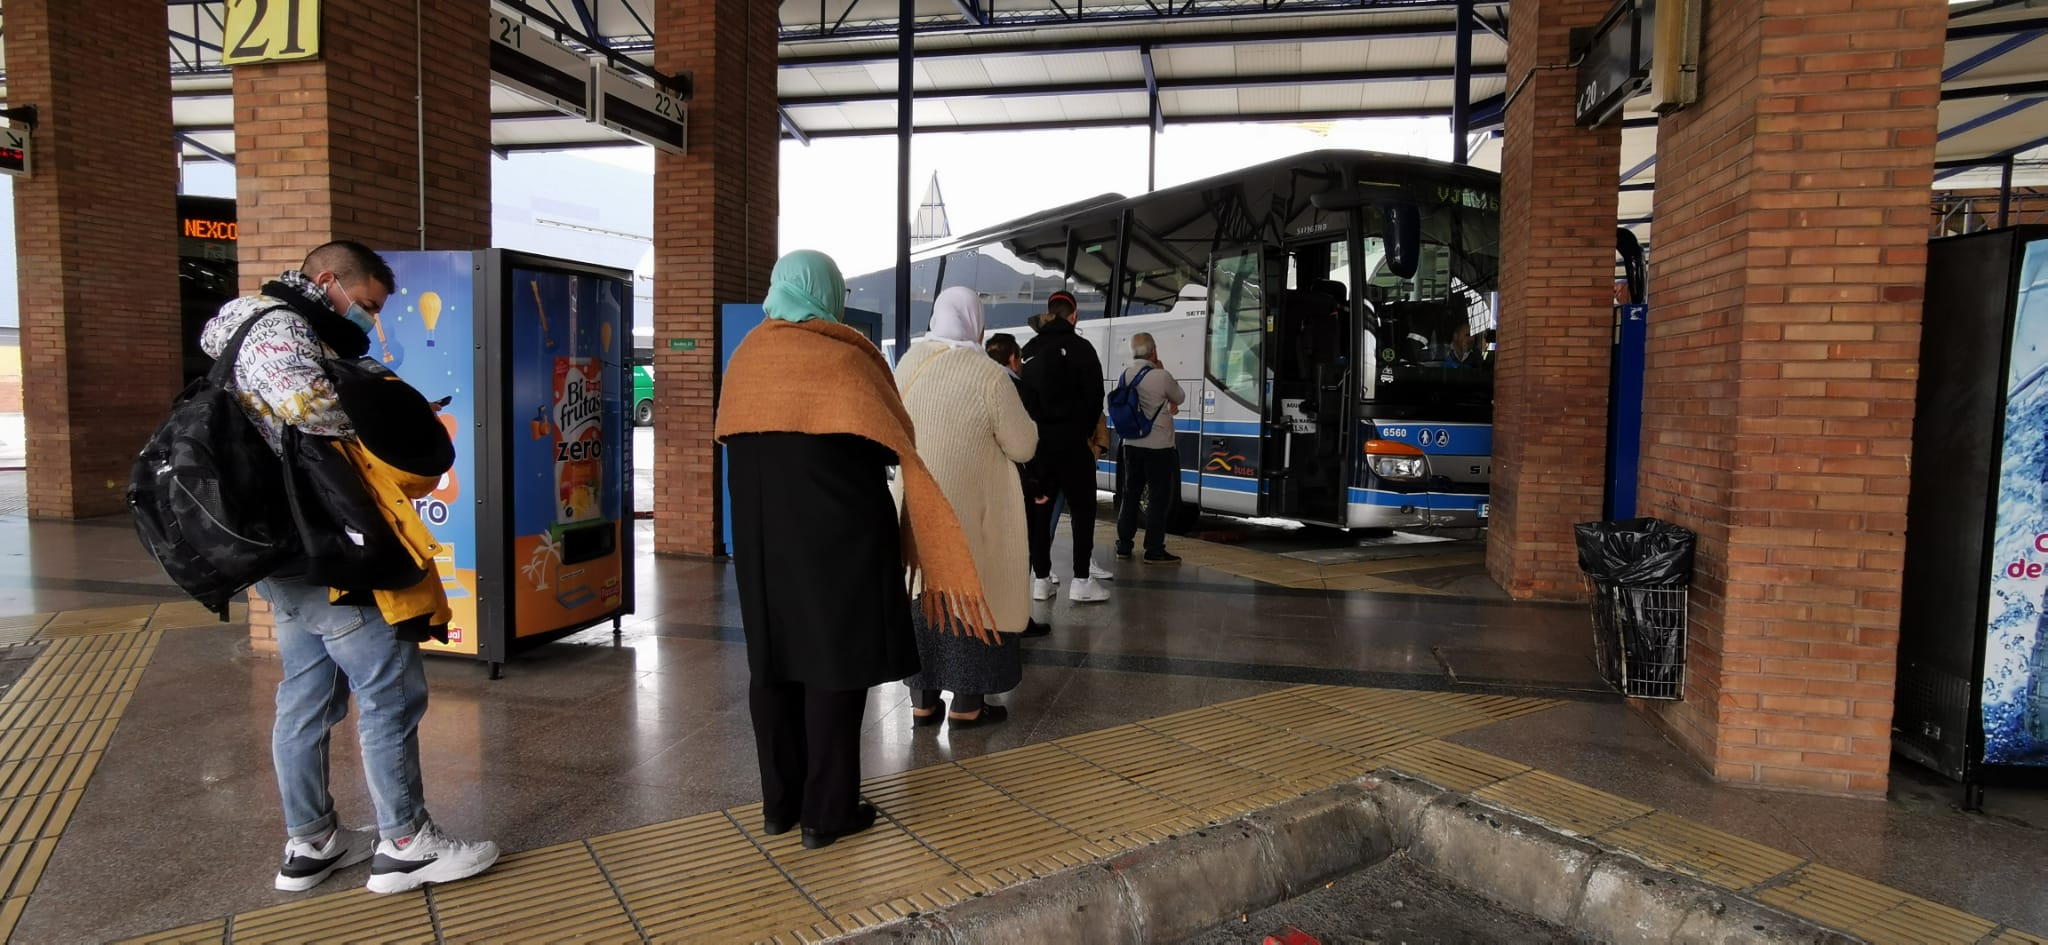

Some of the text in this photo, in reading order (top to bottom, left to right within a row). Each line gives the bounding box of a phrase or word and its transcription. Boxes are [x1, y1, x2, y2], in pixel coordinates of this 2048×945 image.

[229, 0, 306, 58] 21
[500, 17, 521, 48] 21
[655, 93, 671, 117] 22
[1585, 80, 1597, 111] 20
[184, 218, 238, 240] NEXCO
[568, 379, 583, 406] Bi
[560, 395, 601, 432] frutas
[1293, 424, 1309, 432] LSA
[1383, 428, 1407, 437] 6560
[558, 440, 601, 462] zero
[415, 499, 449, 525] ro
[2008, 558, 2043, 579] de
[422, 851, 439, 861] FILA
